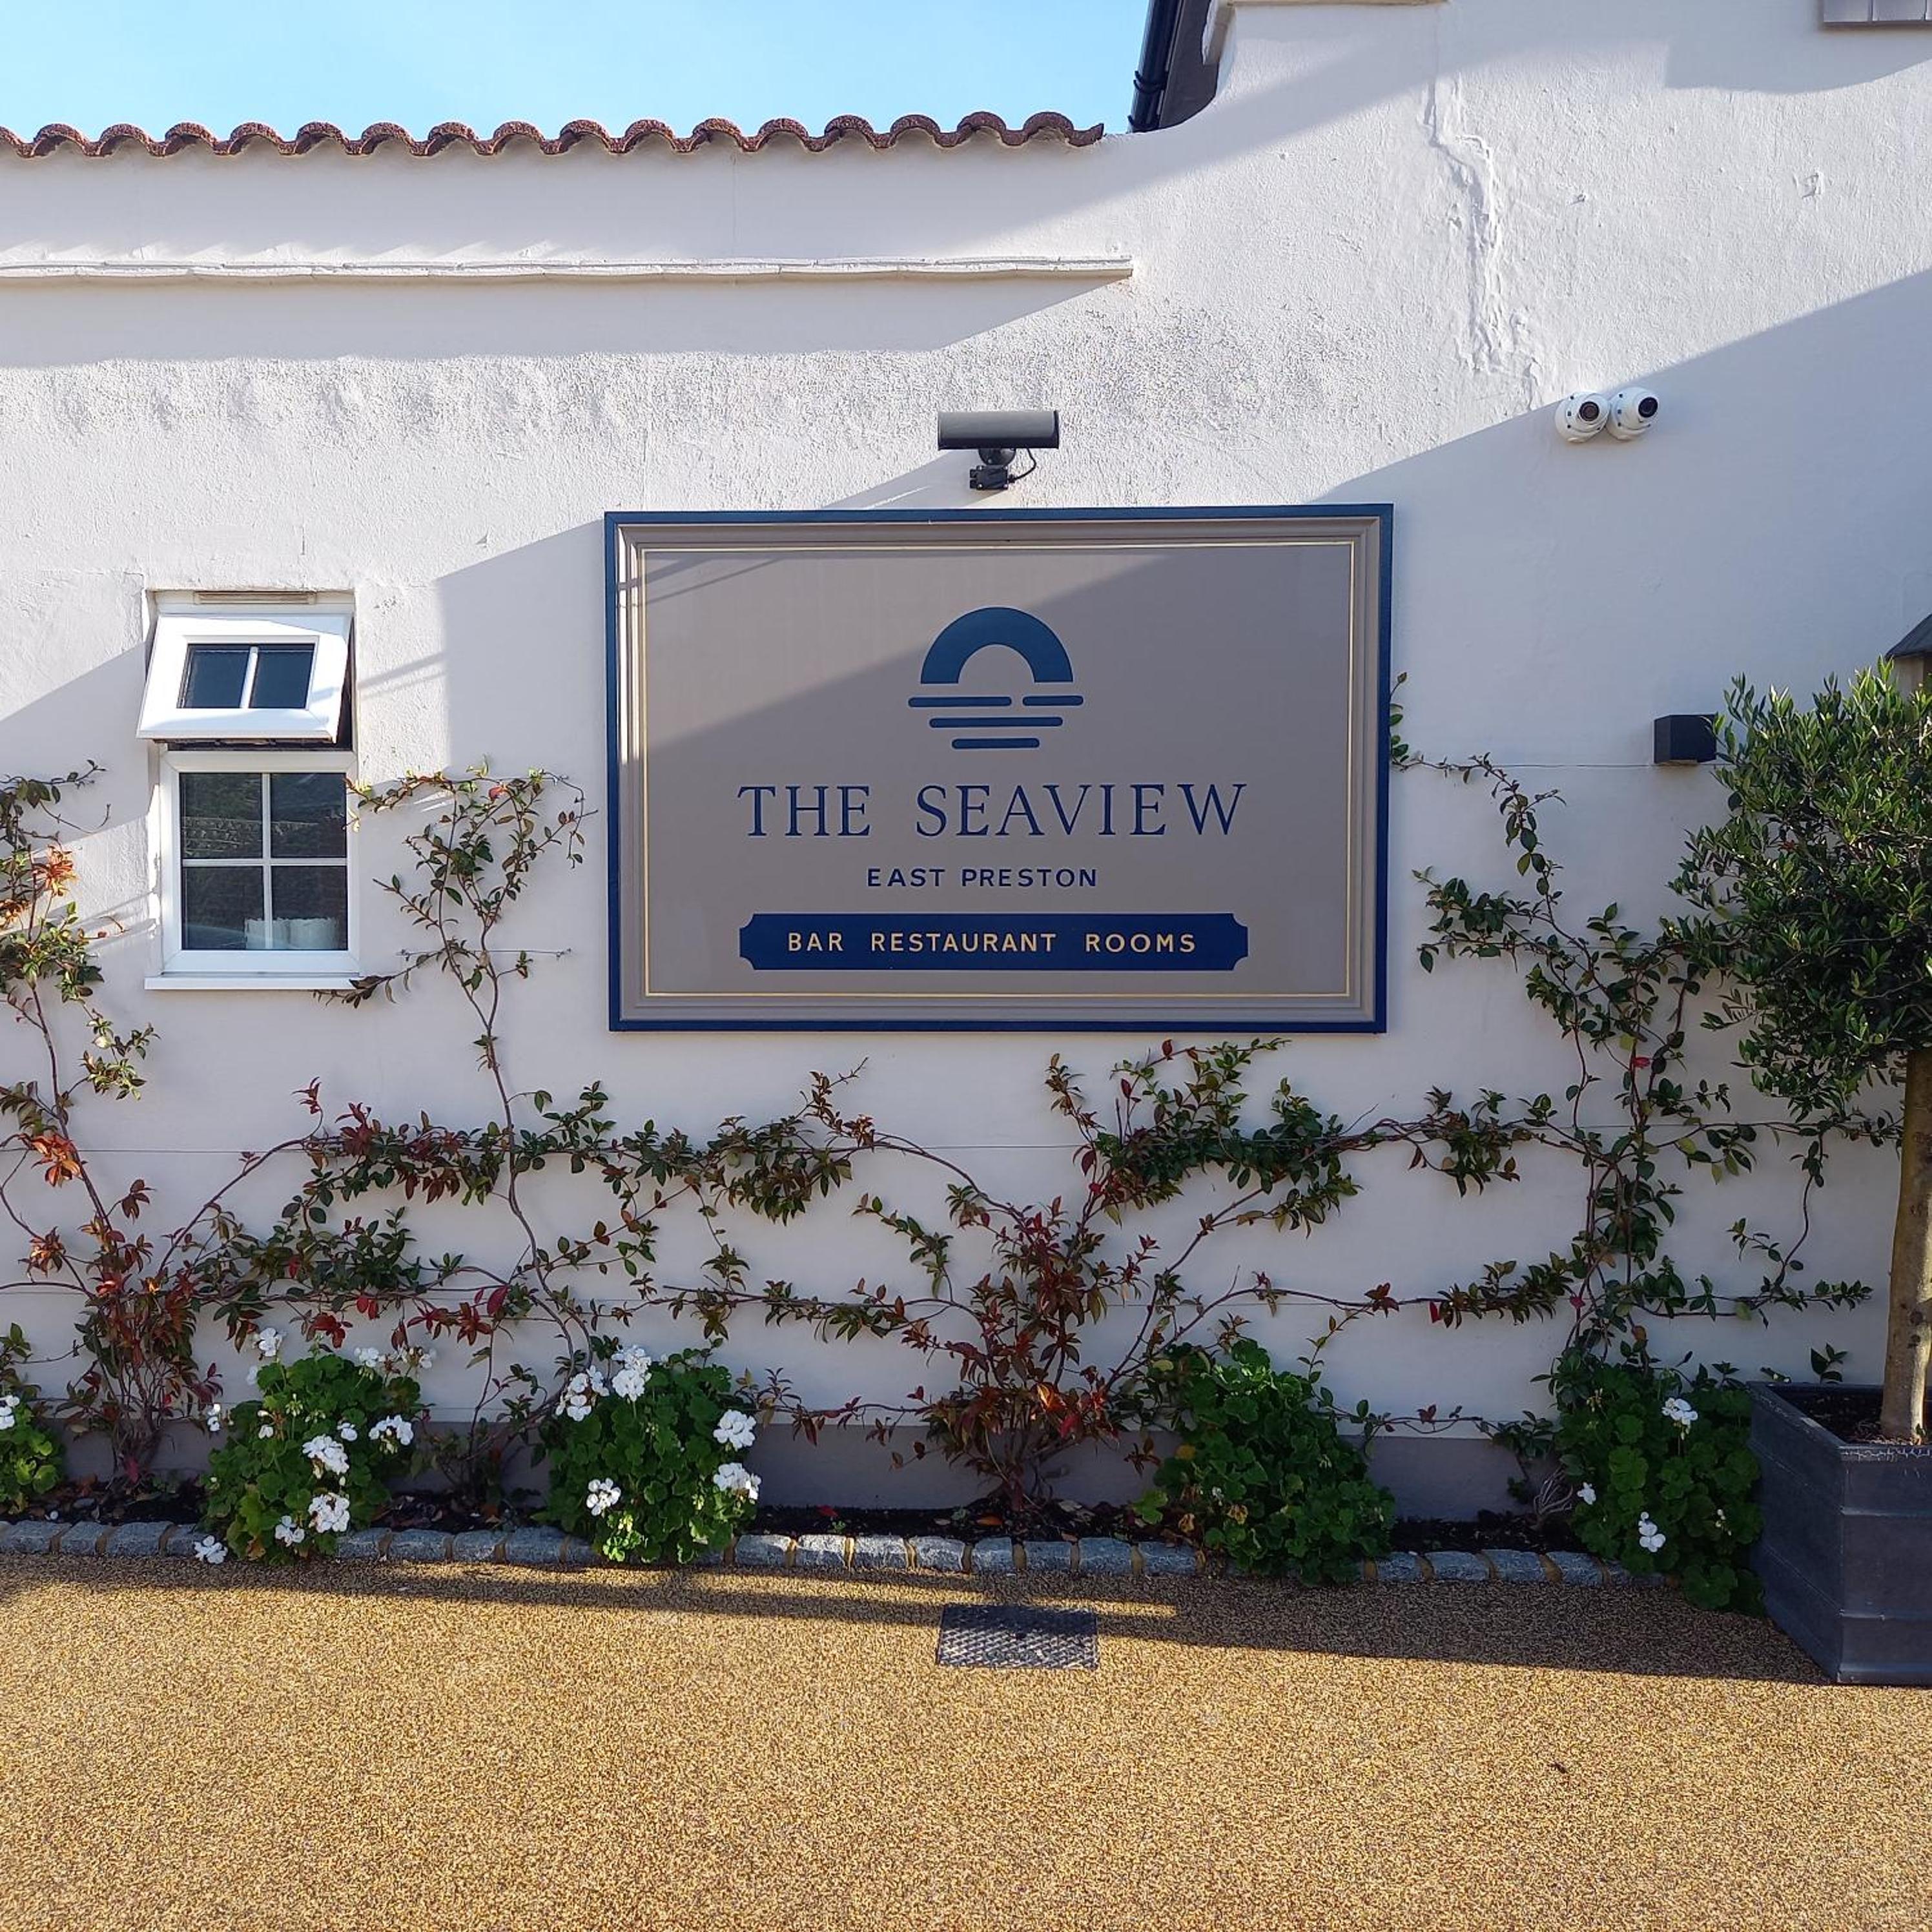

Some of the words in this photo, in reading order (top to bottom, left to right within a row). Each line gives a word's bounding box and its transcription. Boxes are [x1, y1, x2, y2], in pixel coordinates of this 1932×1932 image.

[737, 783, 871, 838] THE
[916, 782, 1248, 838] SEAVIEW
[867, 868, 945, 887] EAST
[961, 868, 1097, 887] PRESTON
[788, 932, 844, 952] BAR
[871, 932, 1057, 952] RESTAURANT
[1085, 933, 1197, 953] ROOMS
